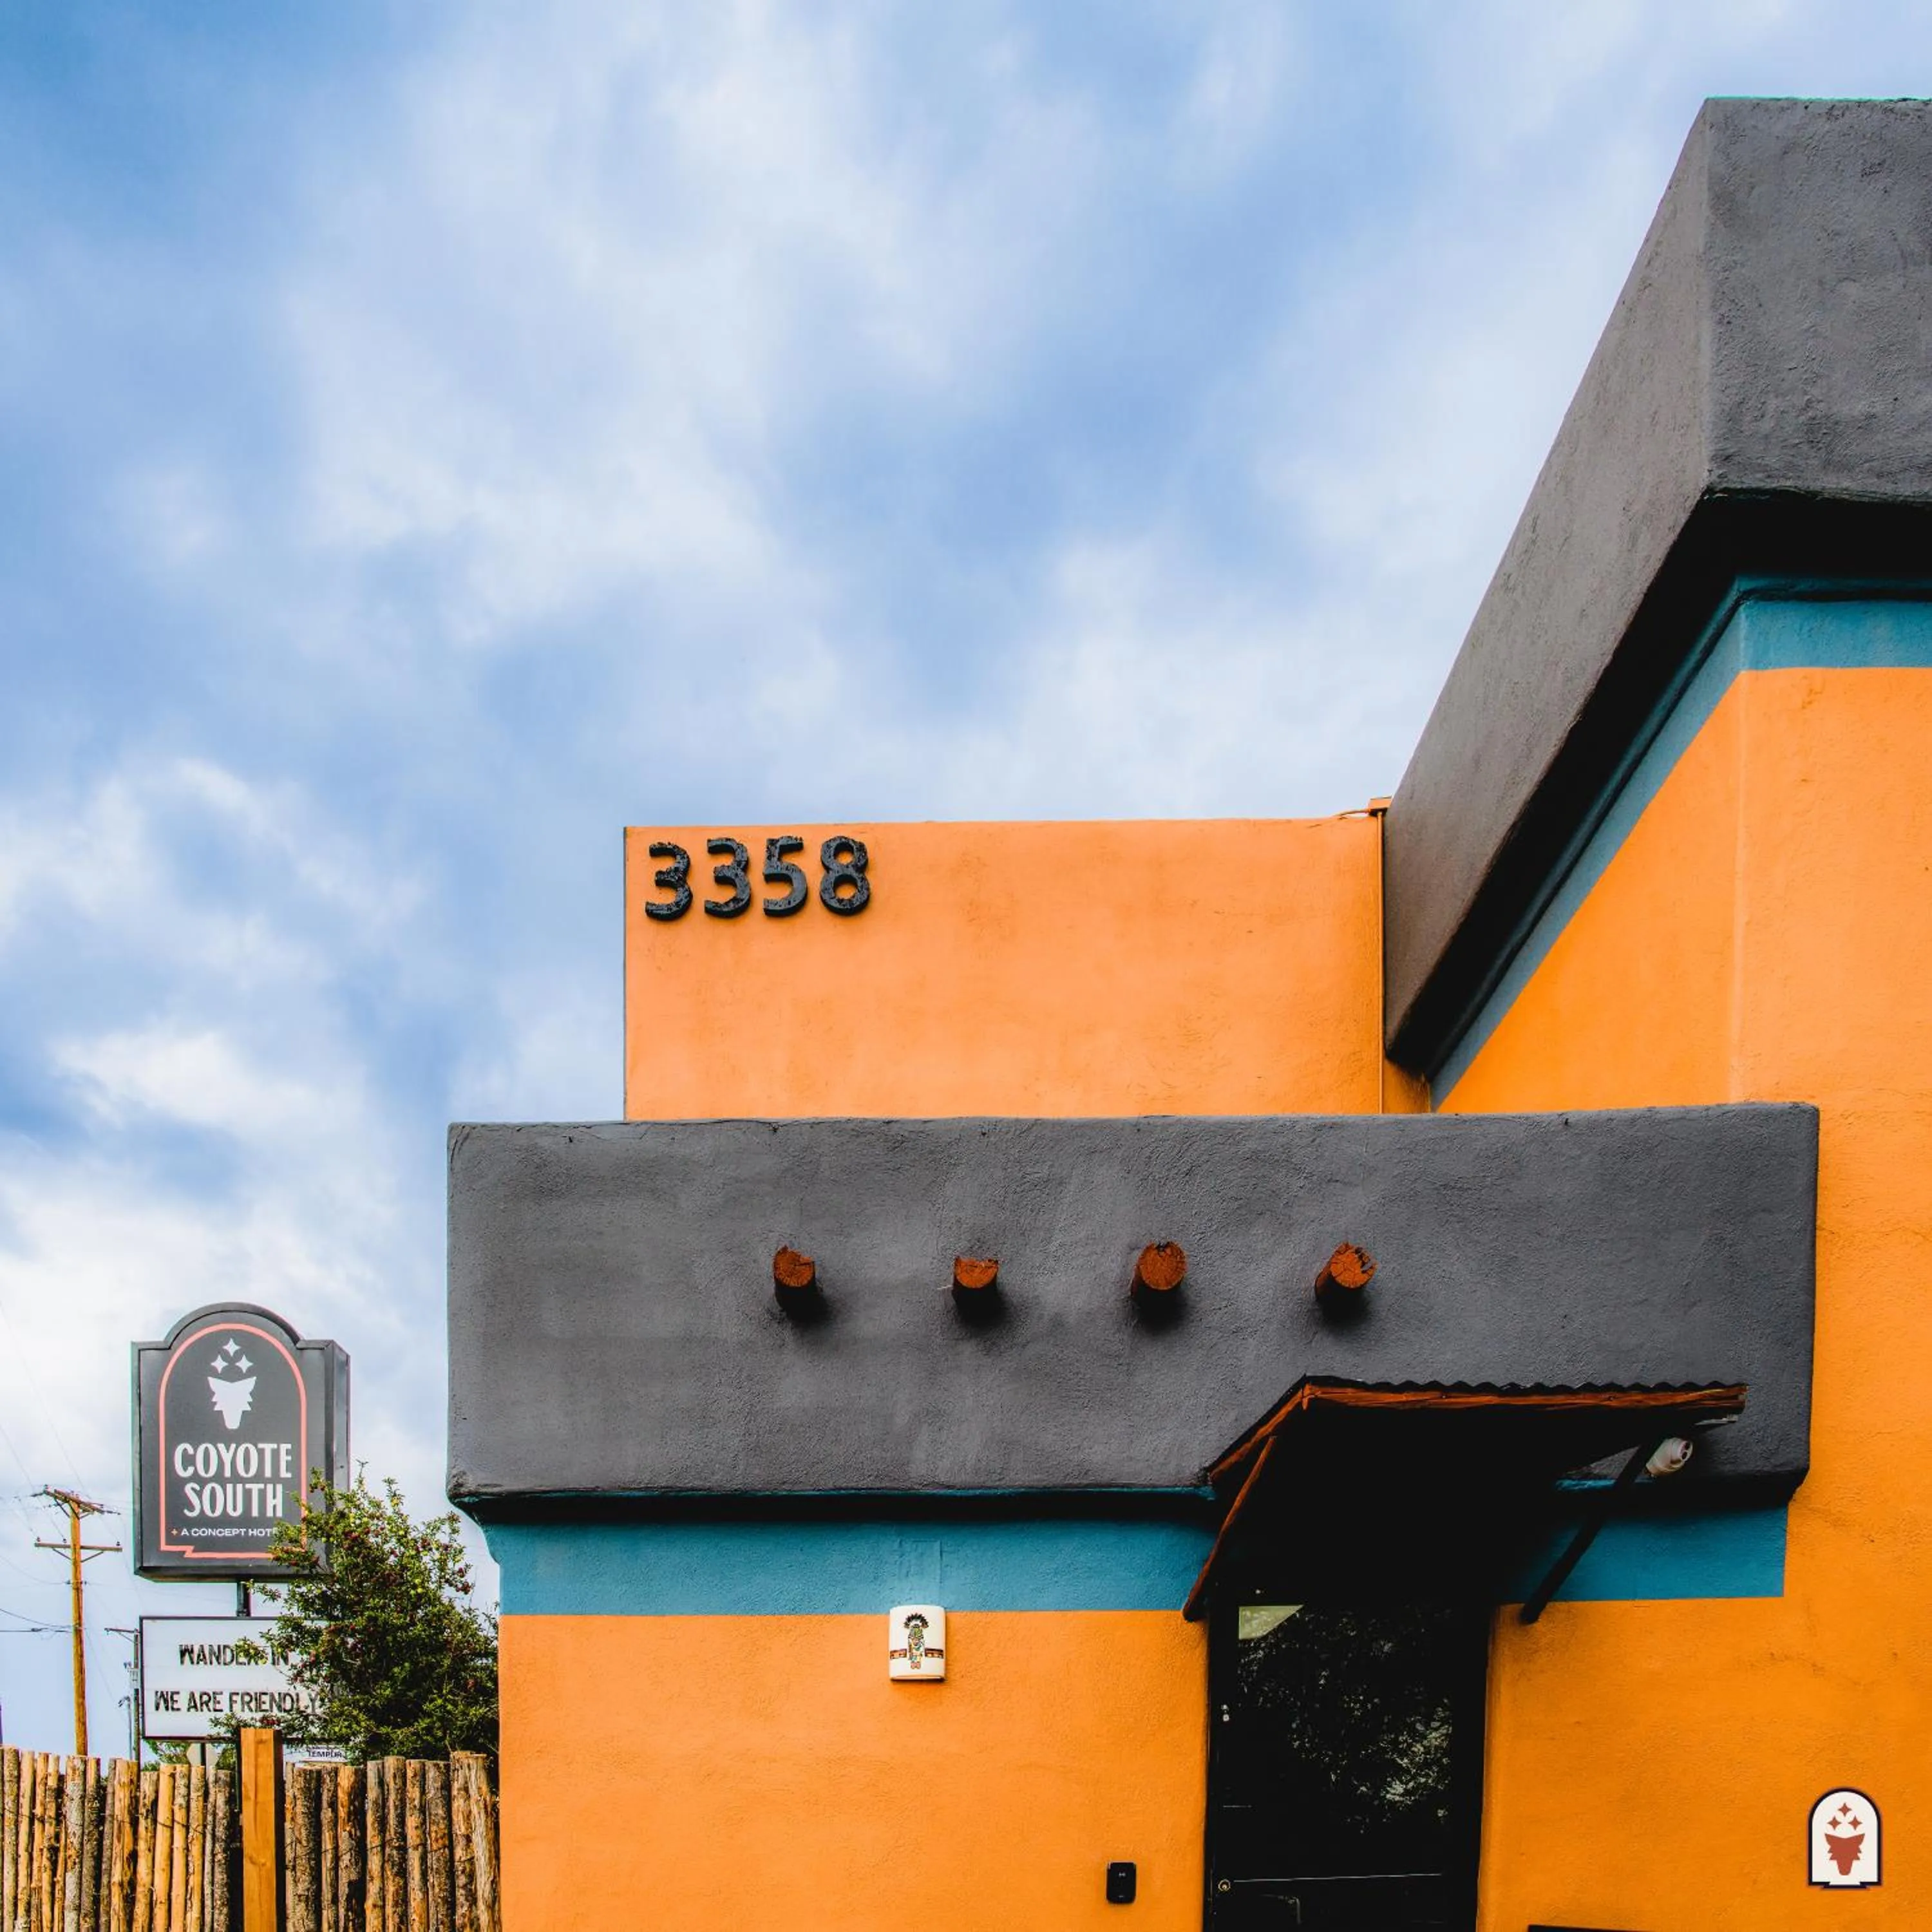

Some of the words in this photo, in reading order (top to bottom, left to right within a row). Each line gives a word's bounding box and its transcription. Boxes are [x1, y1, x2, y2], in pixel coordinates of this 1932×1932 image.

[645, 836, 871, 921] 3358
[174, 1443, 292, 1479] COYOTE
[183, 1482, 283, 1518] SOUTH
[181, 1528, 189, 1537] A
[191, 1528, 247, 1537] CONCEPT
[155, 1690, 181, 1711] WE
[187, 1691, 223, 1712] ARE
